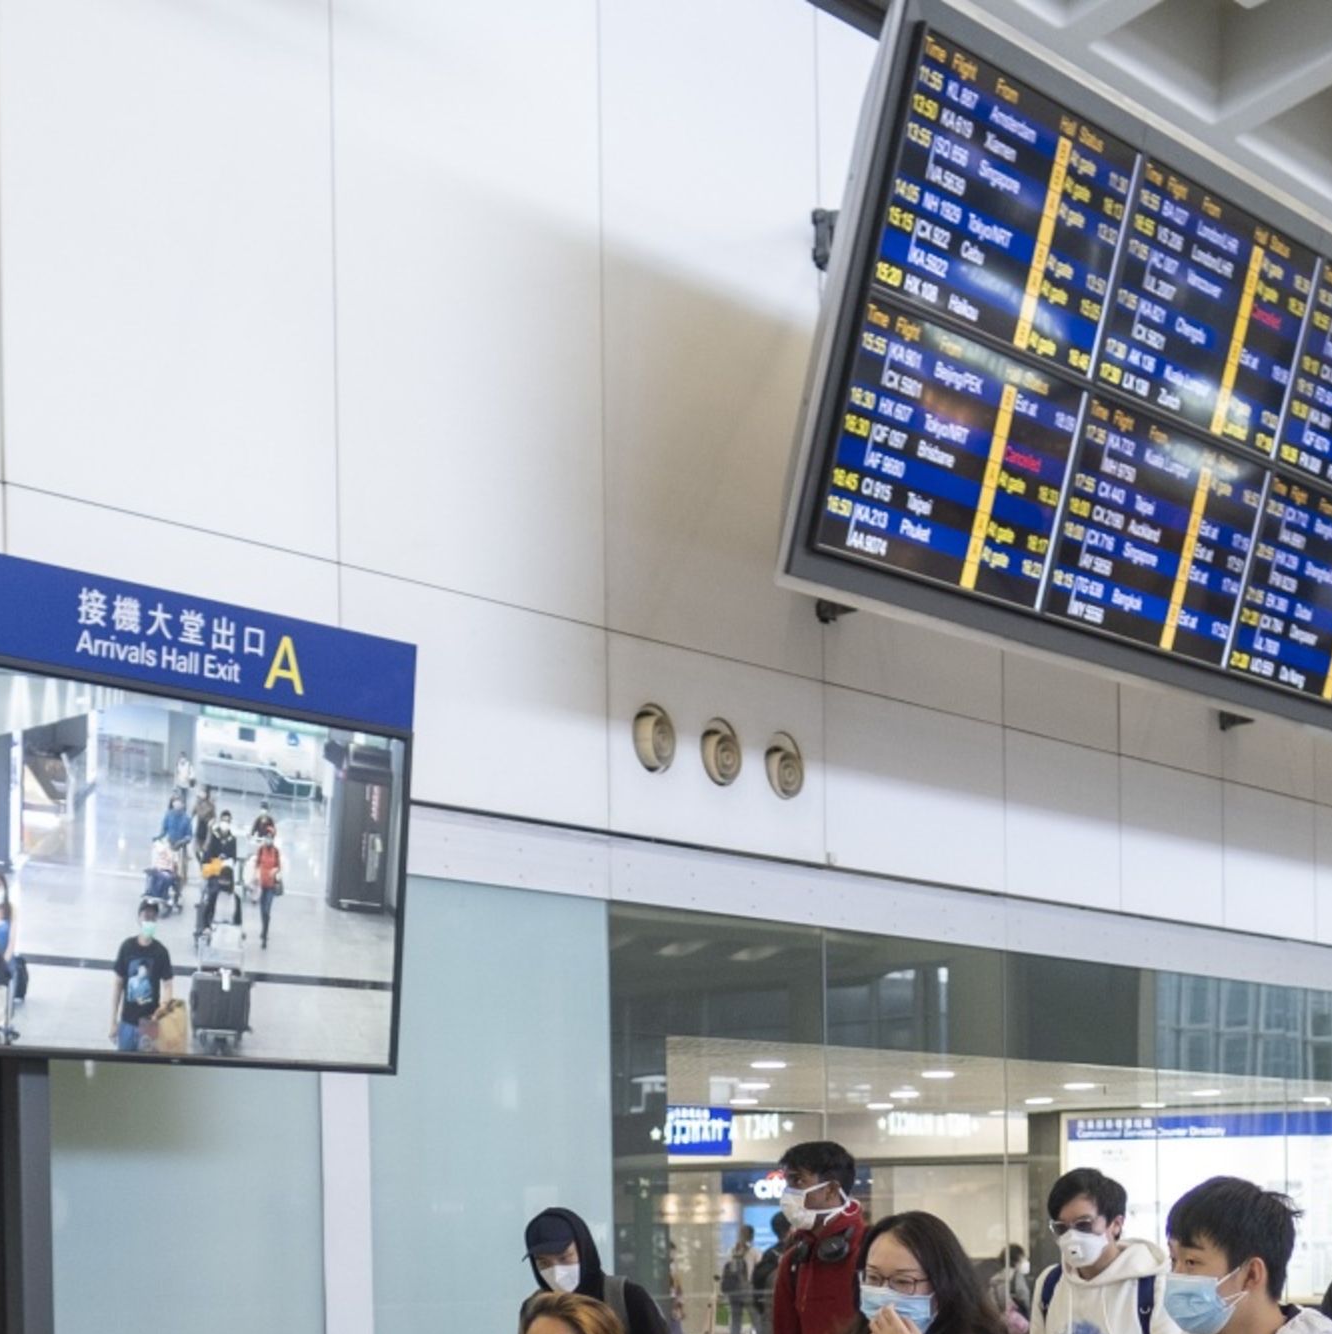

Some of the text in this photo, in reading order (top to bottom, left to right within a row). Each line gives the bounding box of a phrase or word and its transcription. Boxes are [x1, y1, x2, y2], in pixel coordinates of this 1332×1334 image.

[77, 587, 265, 657] 接機大堂出口
[75, 629, 242, 684] Arrivals Hall Exit
[263, 635, 305, 696] A
